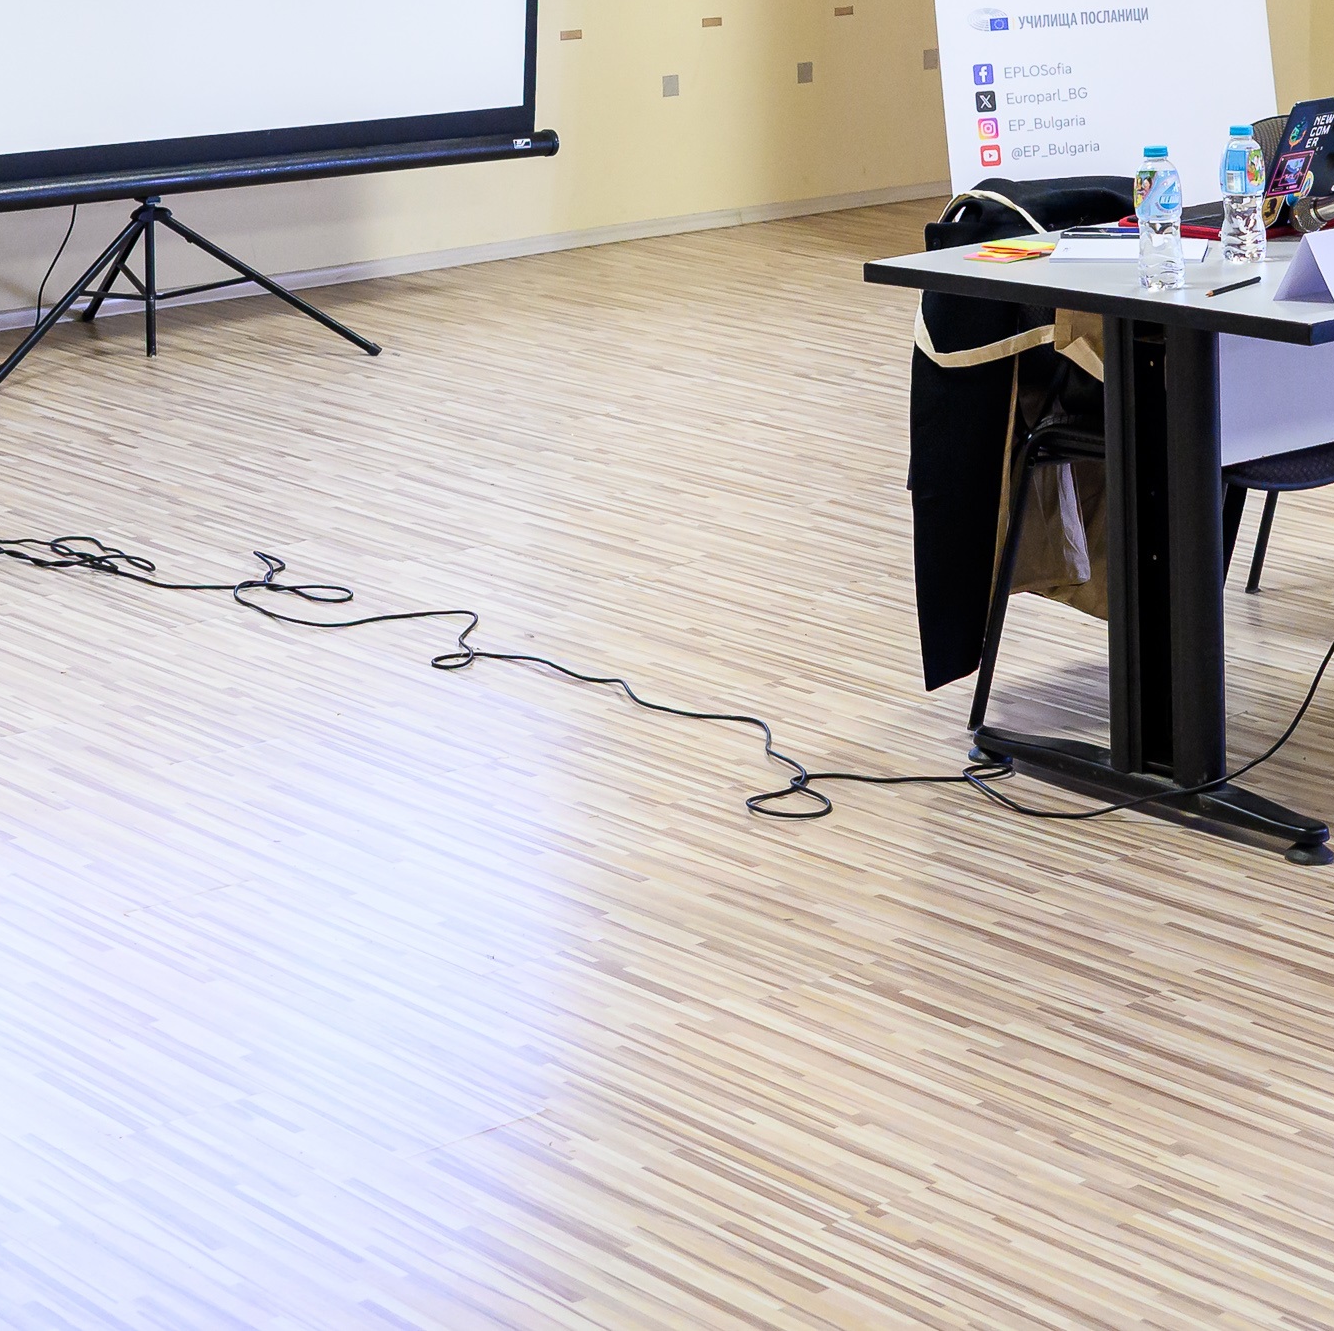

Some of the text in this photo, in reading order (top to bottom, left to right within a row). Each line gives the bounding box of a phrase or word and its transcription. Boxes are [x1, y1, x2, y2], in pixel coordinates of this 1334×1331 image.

[1018, 7, 1149, 29] УЧИЛИЩА ПОСЛАНИЦИ
[1004, 62, 1072, 79] EPLOSofia
[1006, 86, 1088, 105] Europarl_BG
[1009, 115, 1086, 132] EP_Bulgaria
[1309, 125, 1331, 137] COM
[1011, 141, 1100, 160] @EP_Bulgaria
[1305, 137, 1319, 149] ER
